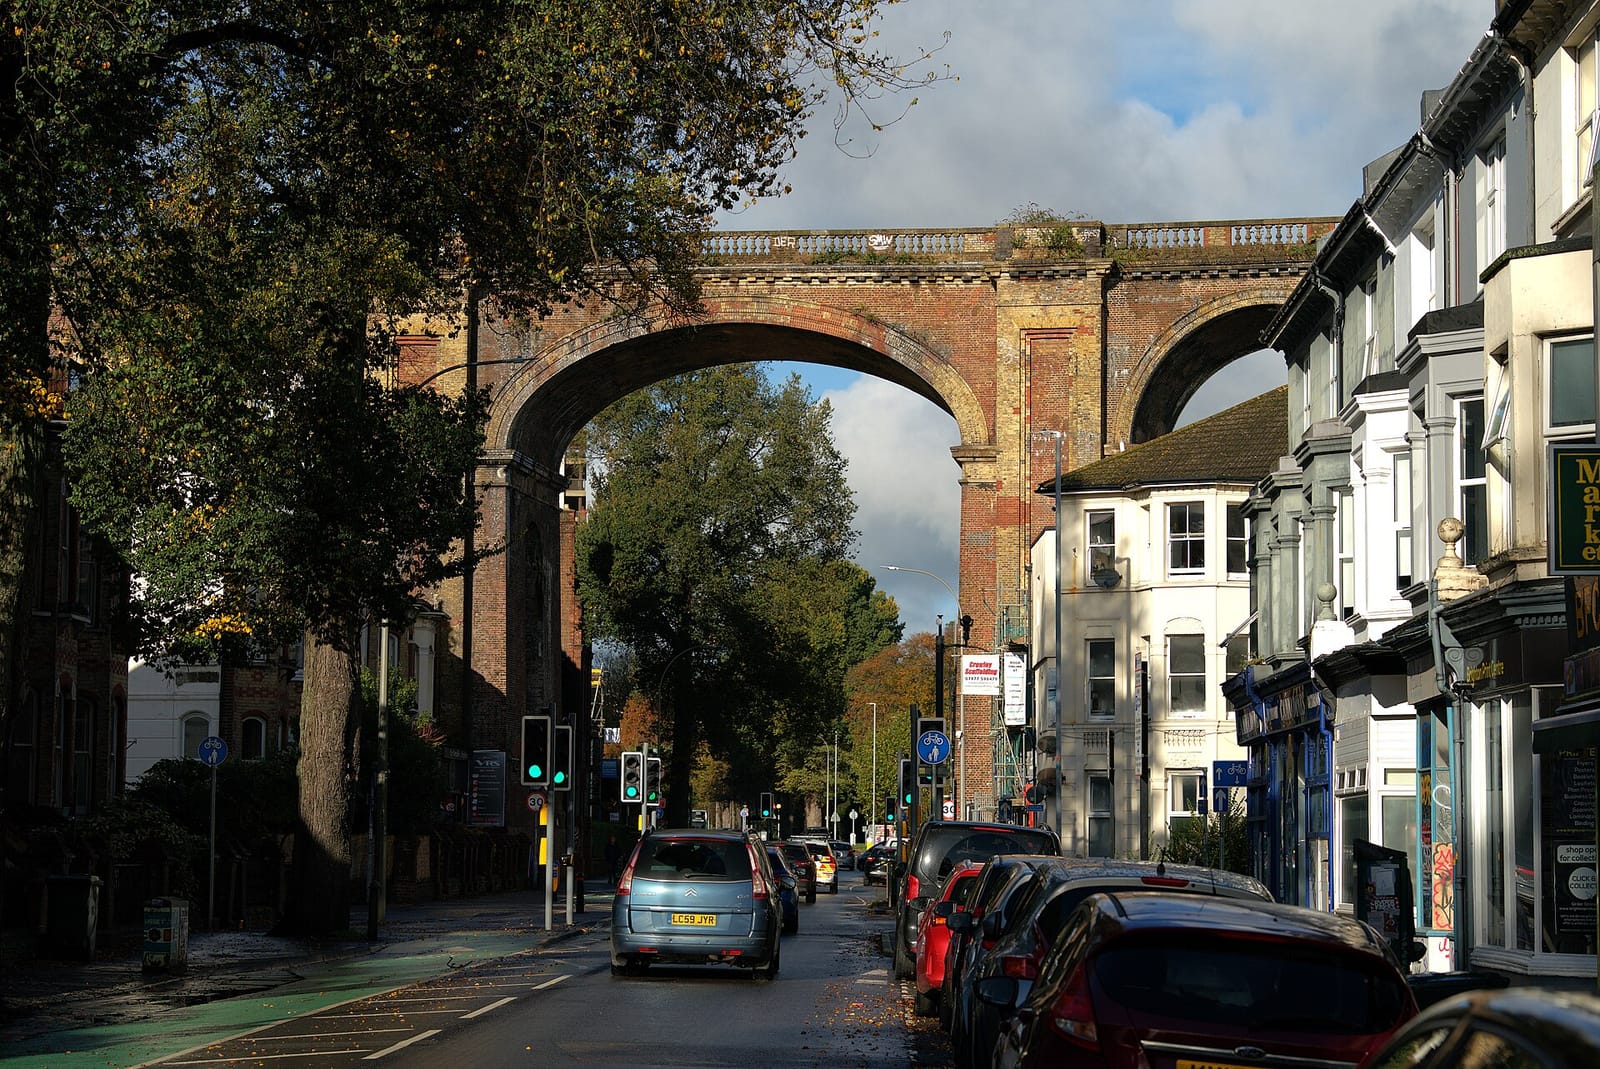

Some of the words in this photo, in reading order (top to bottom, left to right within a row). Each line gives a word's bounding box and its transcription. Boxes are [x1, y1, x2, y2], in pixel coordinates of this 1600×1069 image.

[476, 759, 501, 767] VRS
[529, 798, 543, 806] 30
[672, 914, 695, 924] LC59
[698, 915, 714, 925] JYR
